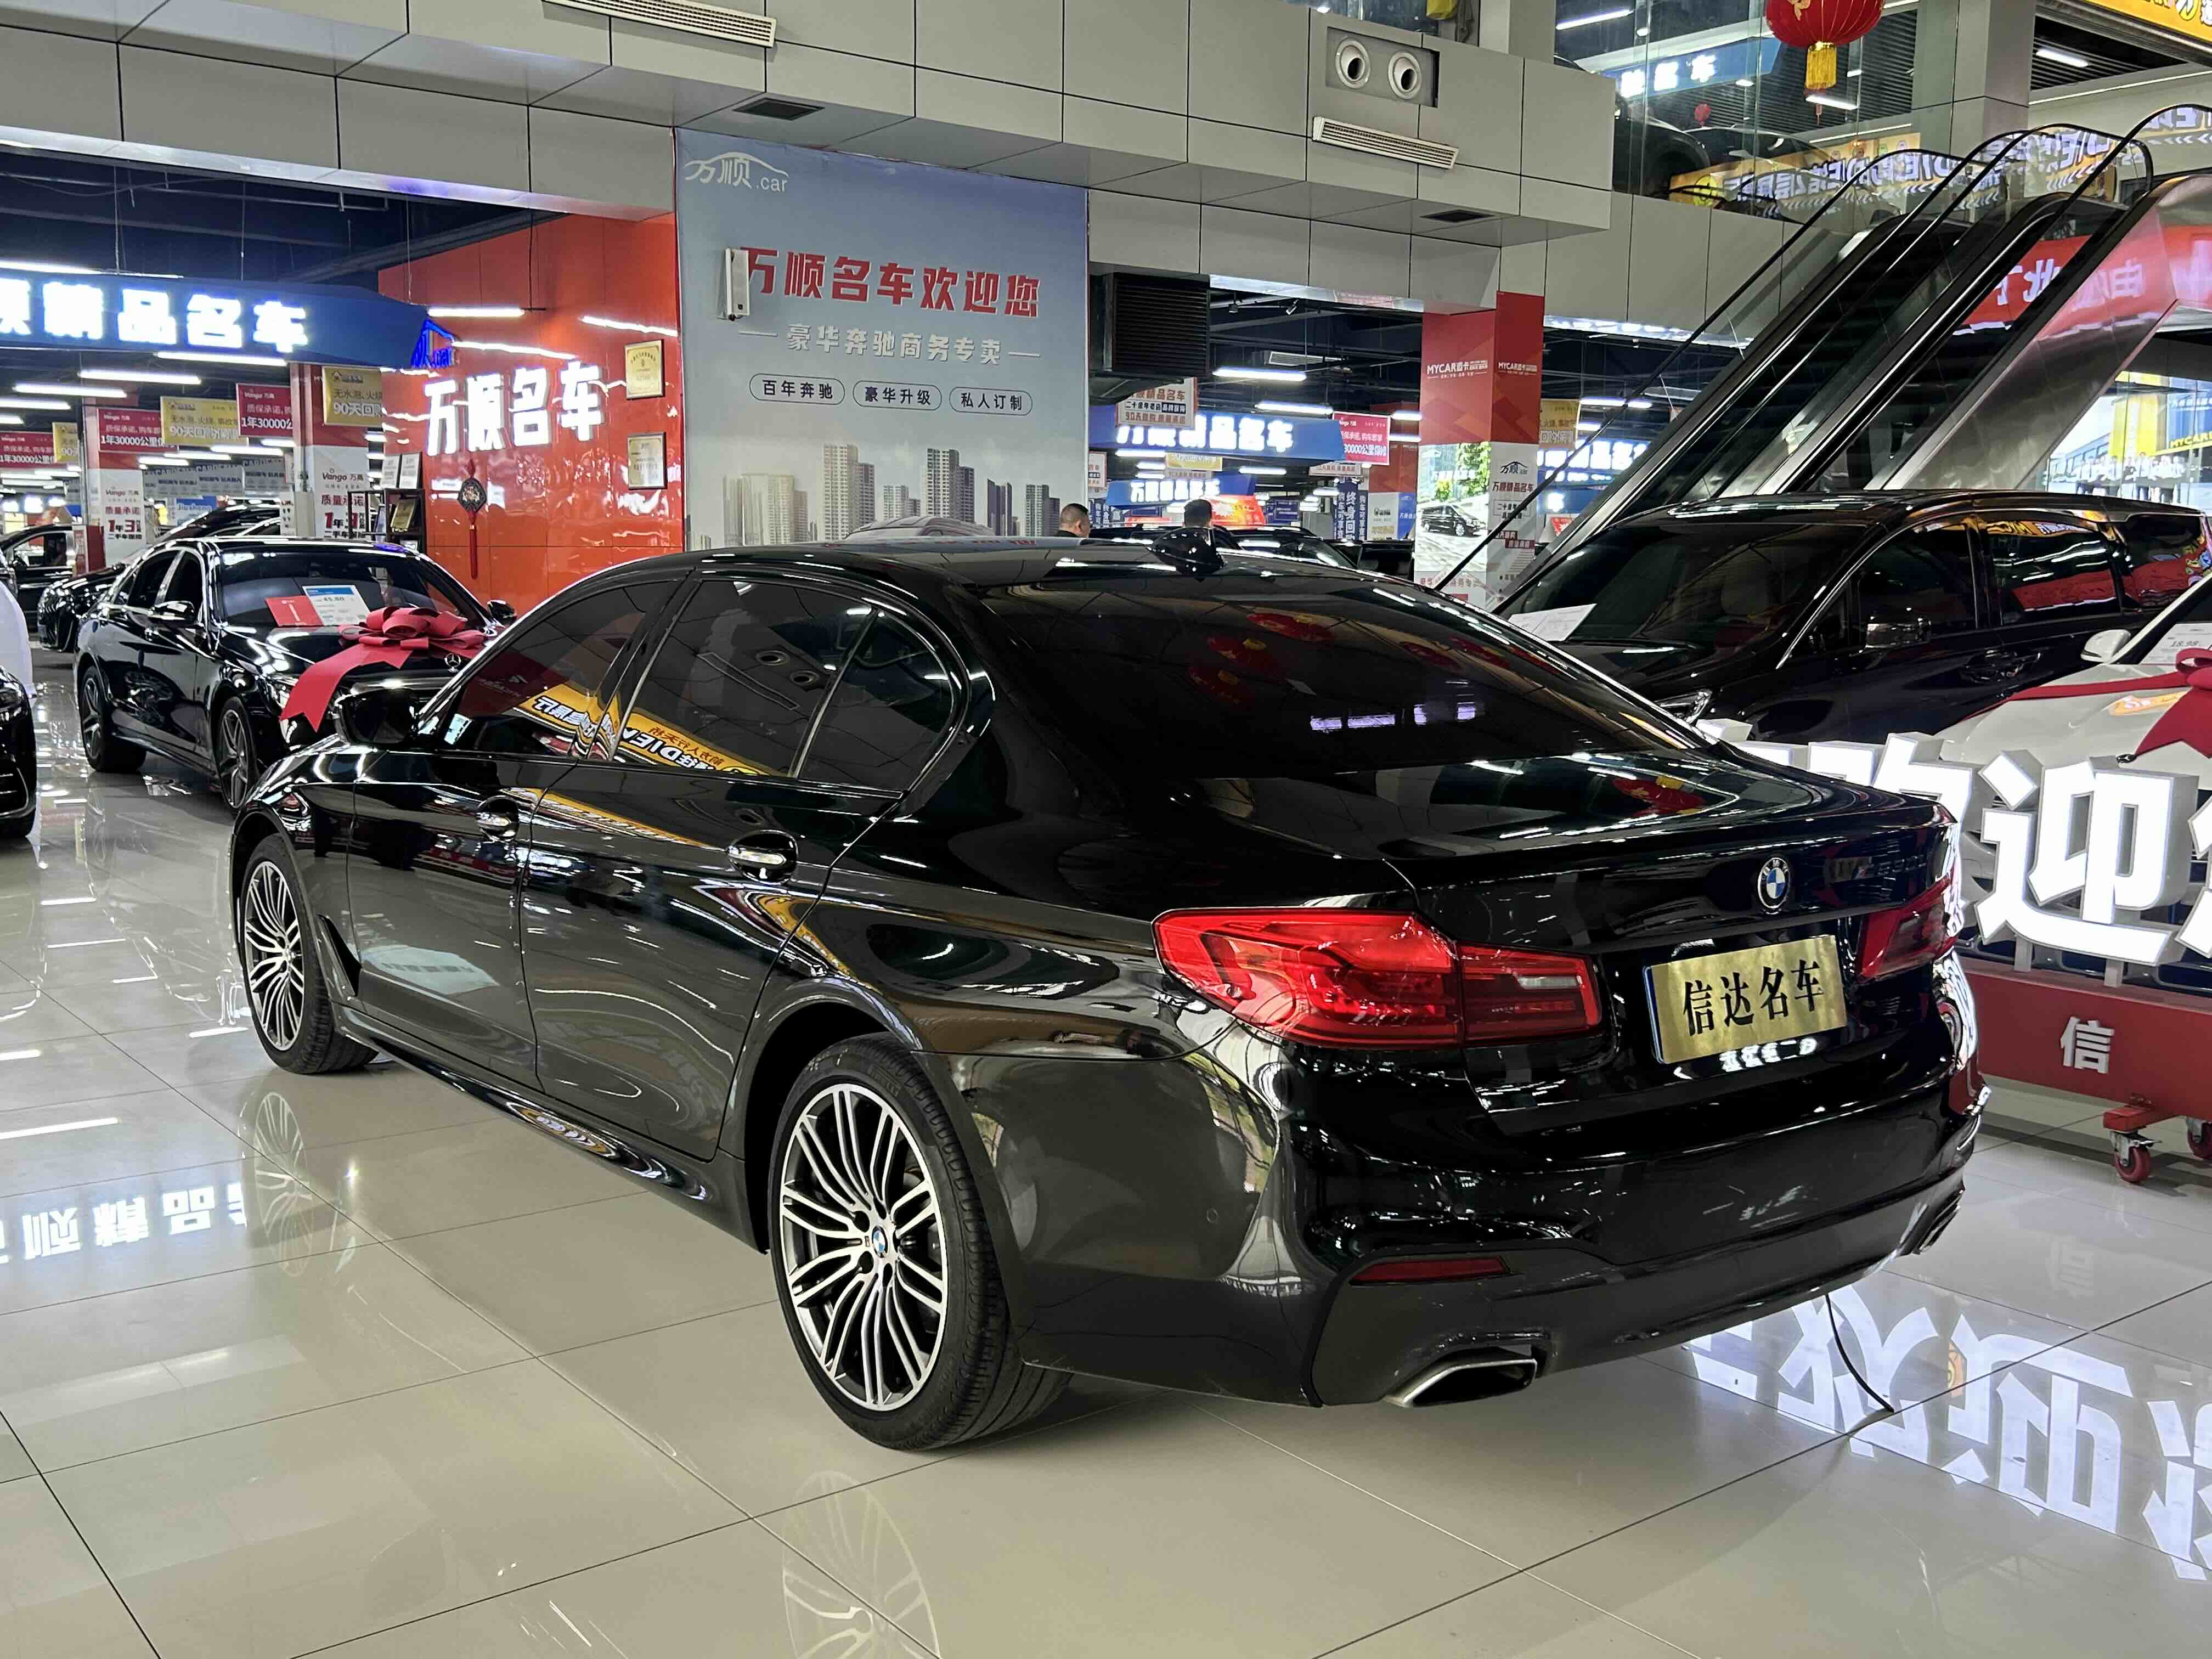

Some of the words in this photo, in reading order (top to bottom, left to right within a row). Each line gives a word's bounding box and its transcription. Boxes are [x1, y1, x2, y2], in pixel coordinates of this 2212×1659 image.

[684, 154, 752, 188] 万顺
[740, 246, 1041, 318] 万顺名车欢迎您
[787, 323, 1001, 365] 豪华奔驰商务专卖
[1427, 362, 1457, 375] MYCAR
[762, 379, 833, 399] 百年奔驰
[865, 386, 932, 406] 豪华升级
[961, 392, 1023, 410] 私人订制
[425, 362, 602, 456] 万顺名车
[323, 472, 347, 482] Vango
[1684, 959, 1824, 1036] 信达名车
[2060, 1016, 2115, 1074] 信
